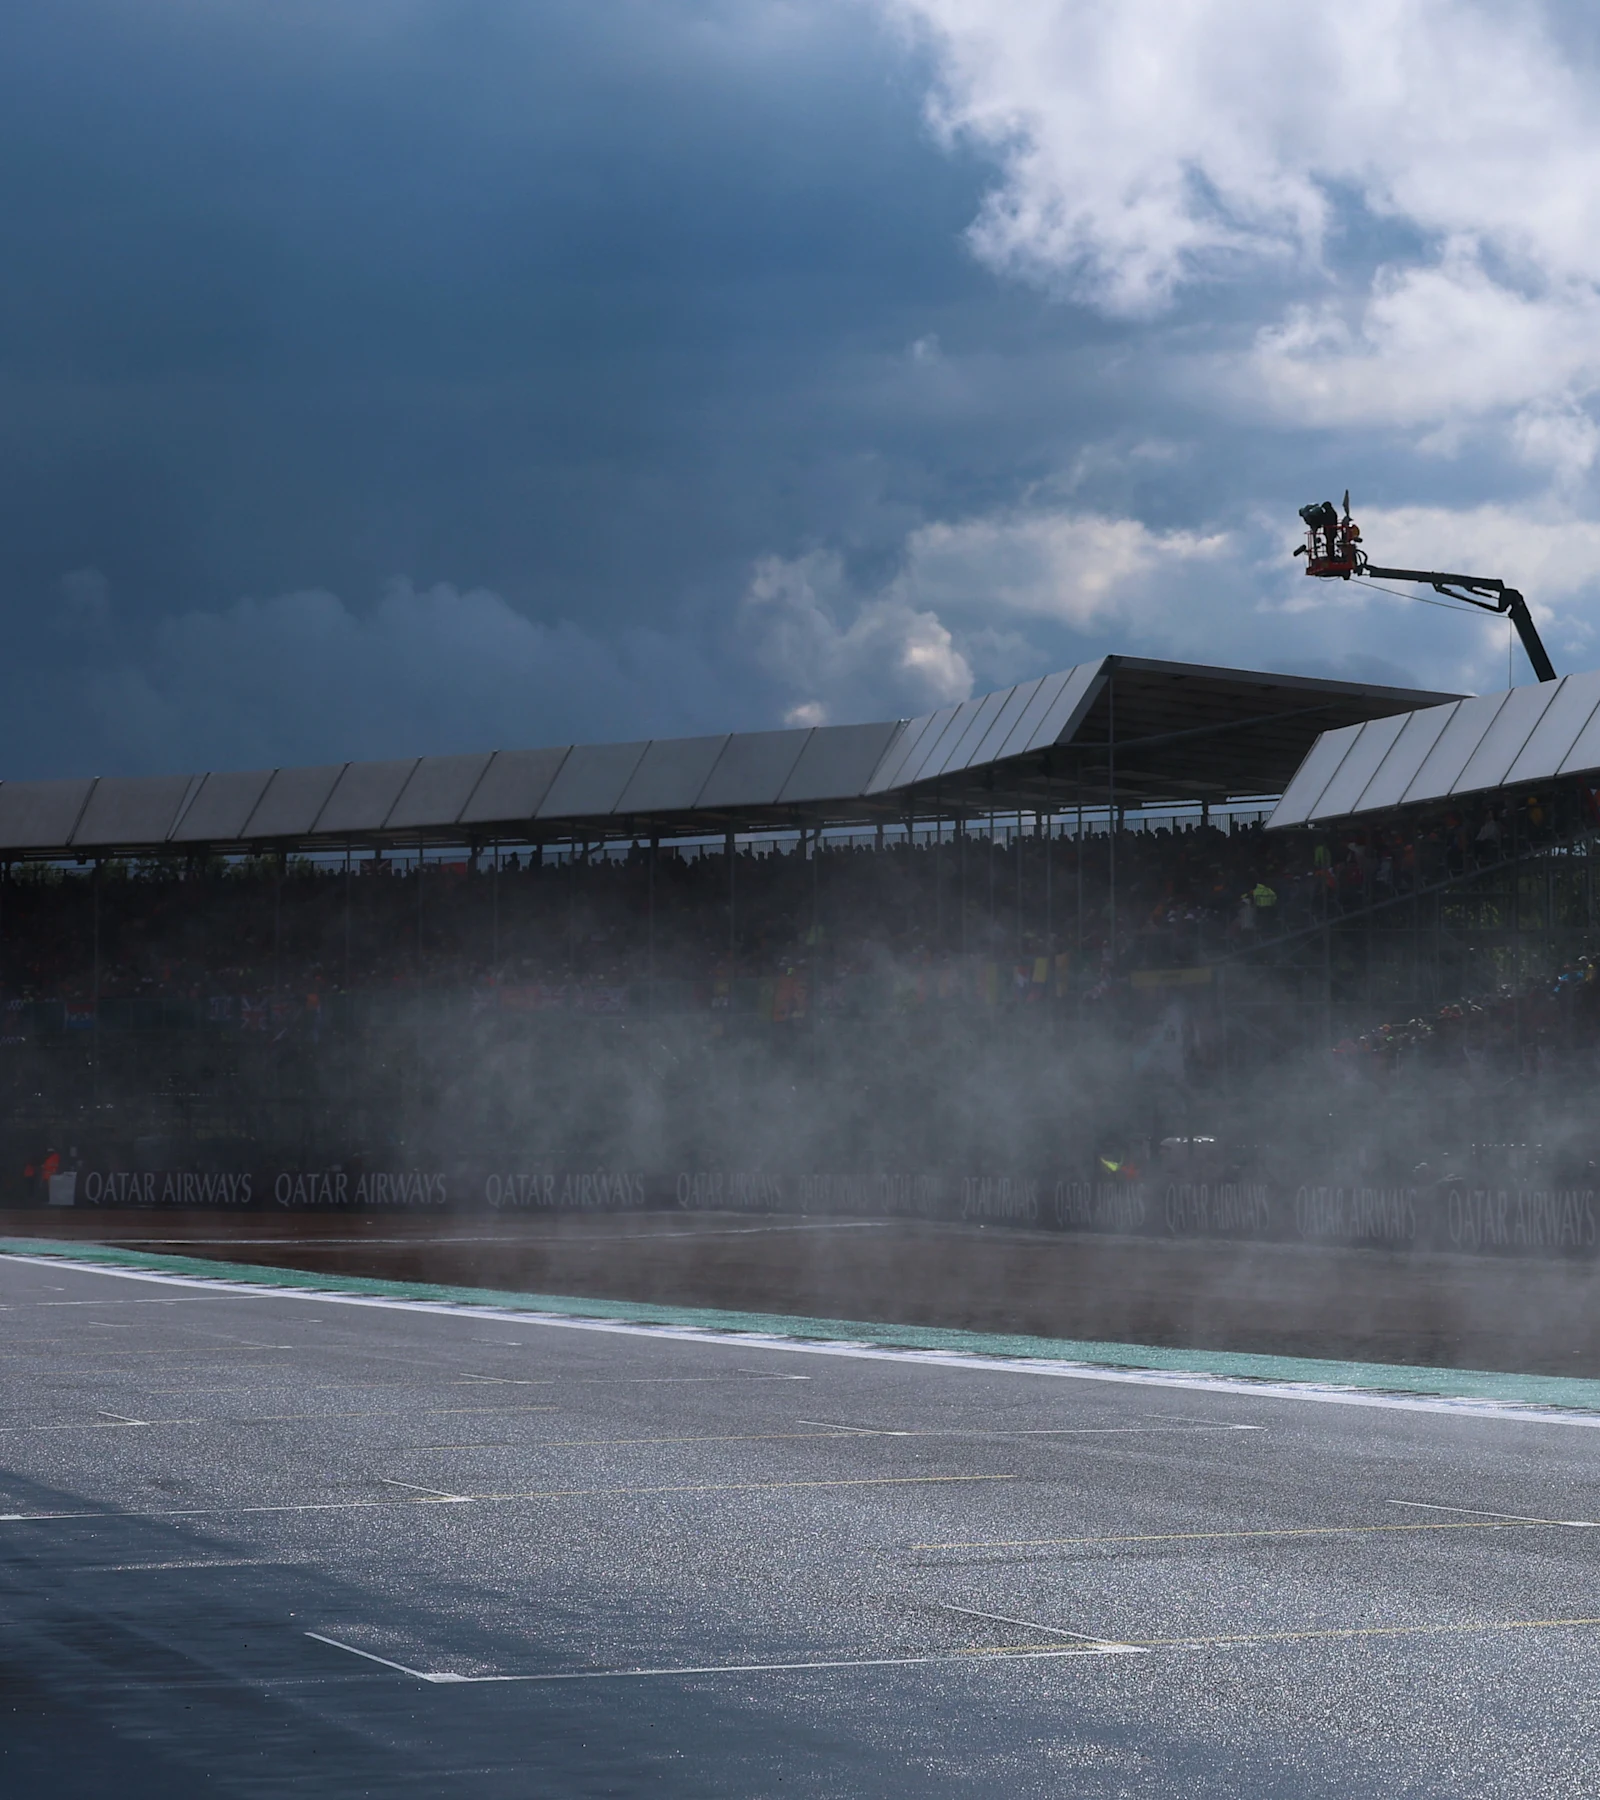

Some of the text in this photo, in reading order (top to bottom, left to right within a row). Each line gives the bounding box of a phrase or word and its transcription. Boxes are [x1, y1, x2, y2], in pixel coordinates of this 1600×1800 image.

[85, 1171, 252, 1204] QATAR AIRWAYS
[274, 1172, 447, 1207] QATAR AIRWAYS
[485, 1172, 645, 1208] QATAR AIRWAYS
[676, 1172, 724, 1208] QATAR
[1055, 1180, 1092, 1227] QATAR
[1165, 1182, 1270, 1232] QATAR AIRWAYS
[1296, 1185, 1416, 1240] QATAR AIRWAYS
[1448, 1188, 1596, 1250] QATAR AIRWAYS
